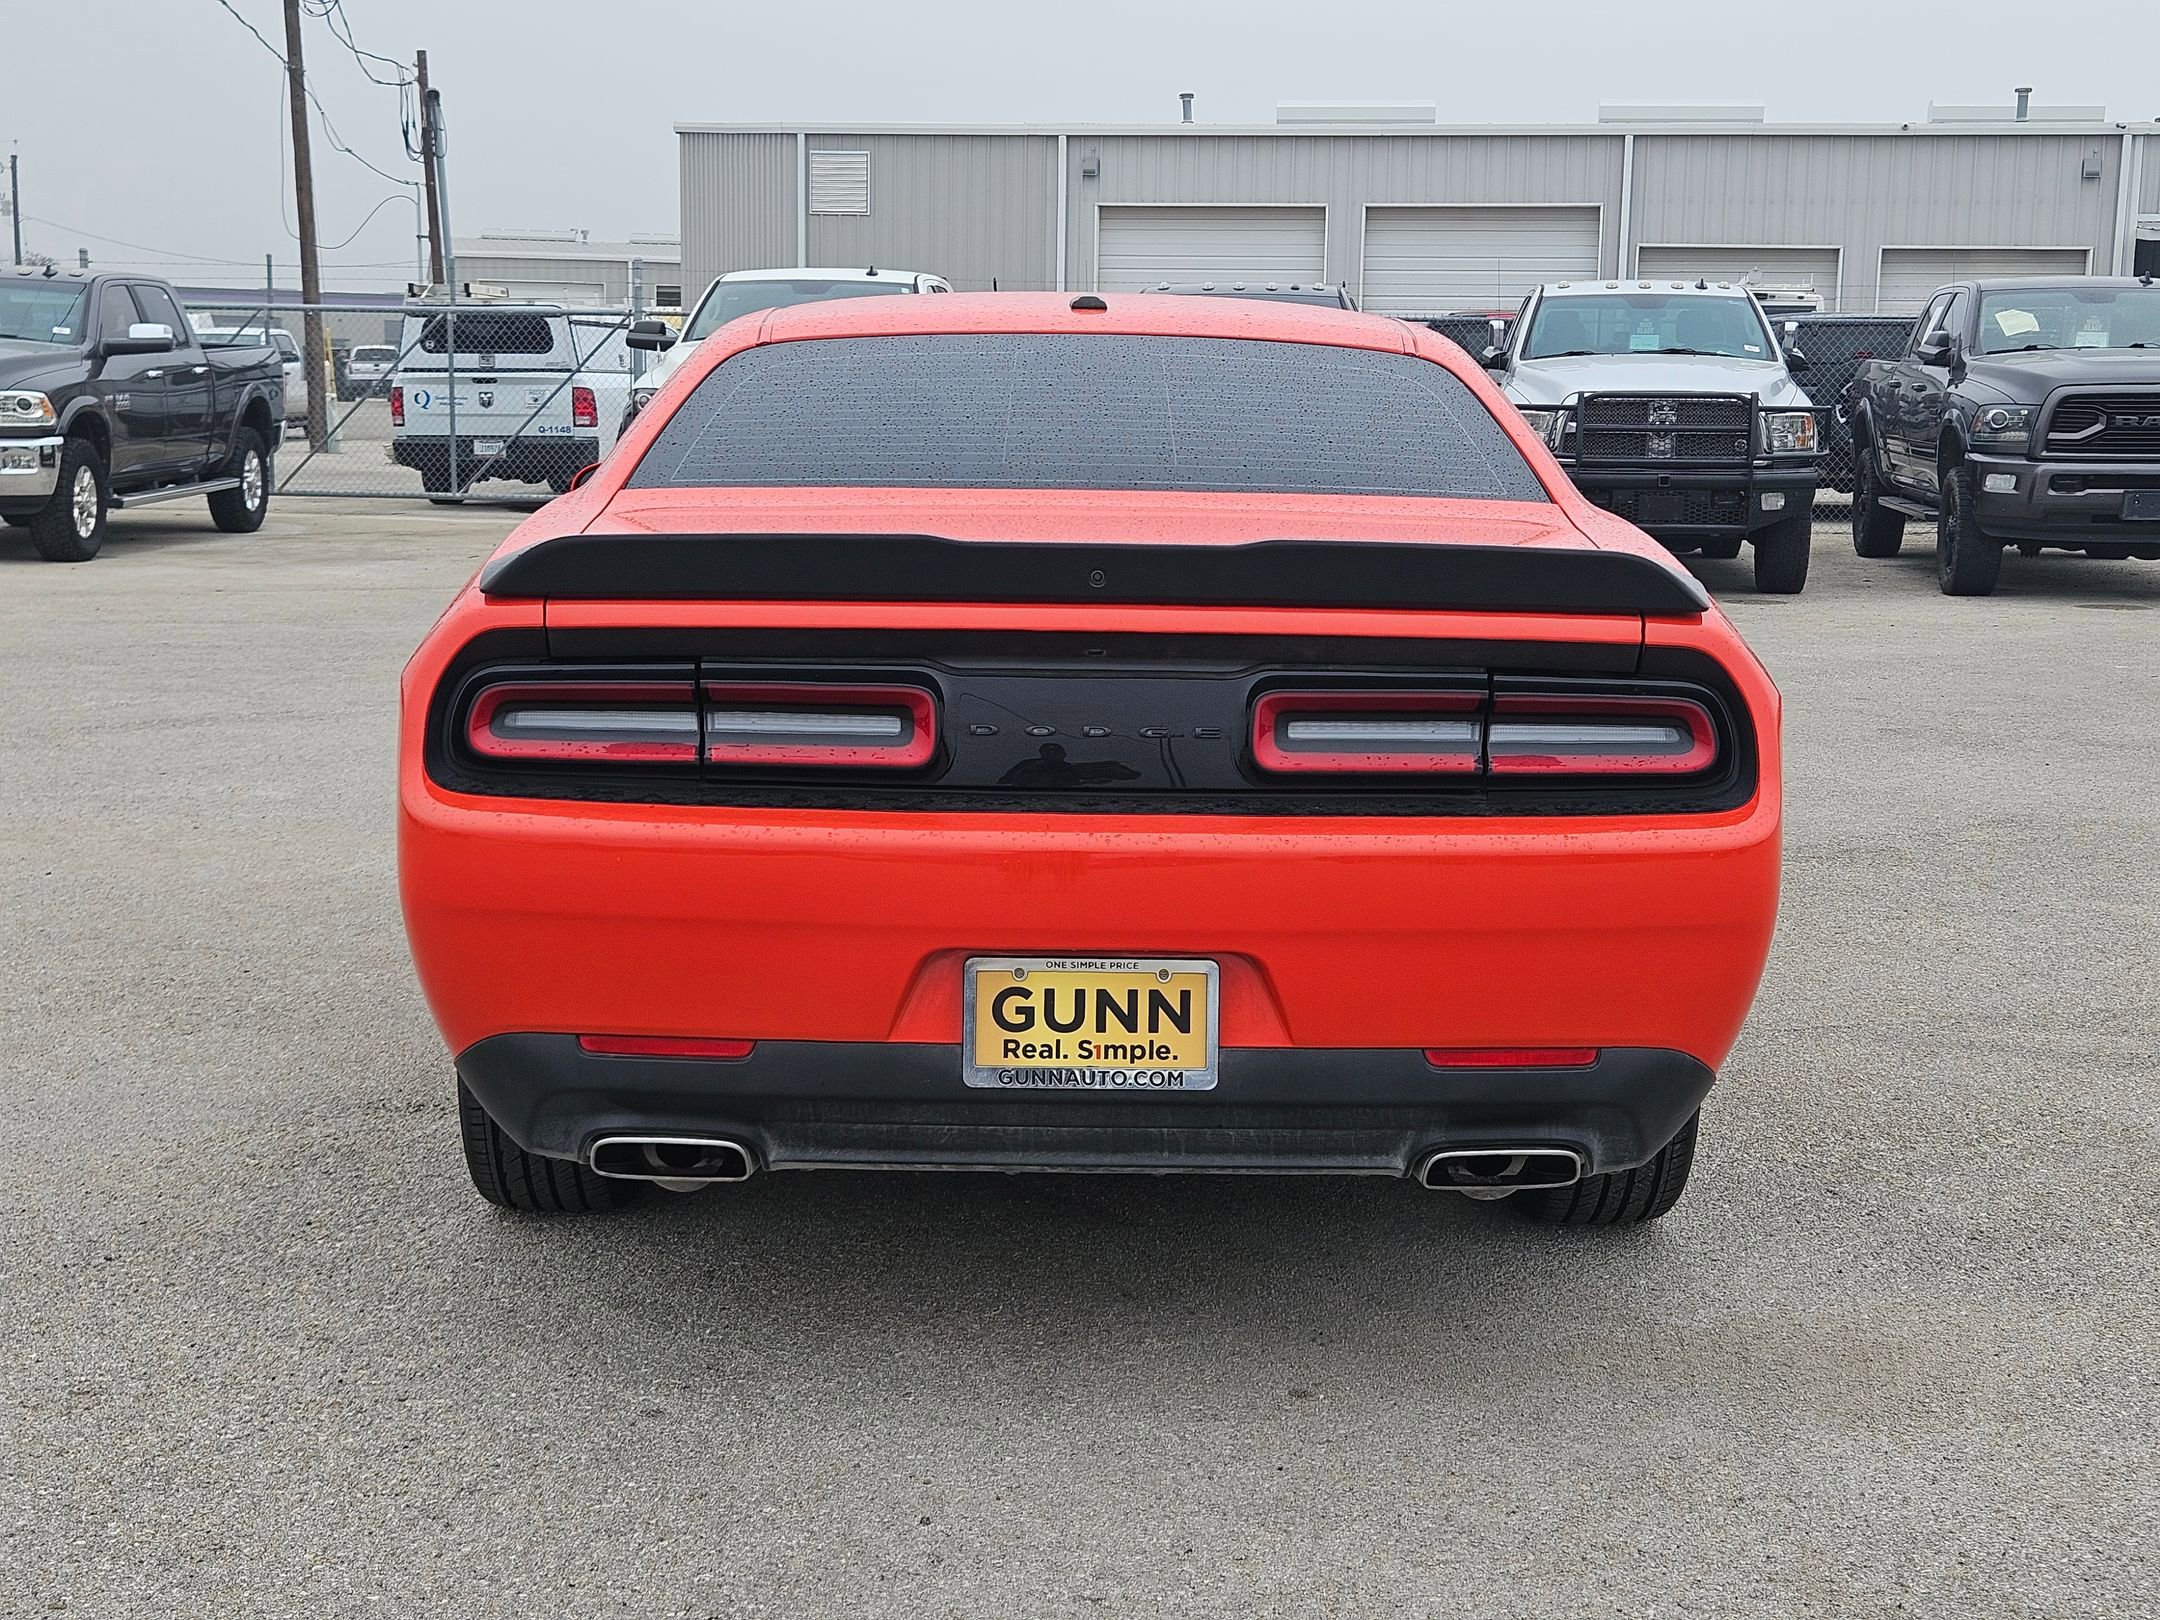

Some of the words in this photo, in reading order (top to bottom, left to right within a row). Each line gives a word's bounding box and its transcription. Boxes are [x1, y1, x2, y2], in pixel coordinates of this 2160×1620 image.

[538, 425, 572, 434] Q-1148
[969, 724, 1222, 739] DODGE
[1045, 961, 1067, 969] ONE
[1070, 961, 1107, 970] SIMPLE
[1109, 961, 1139, 970] PRICE
[991, 986, 1192, 1034] GUNN
[1003, 1039, 1069, 1060] Real.
[998, 1069, 1184, 1087] GUNNAUTO.COM
